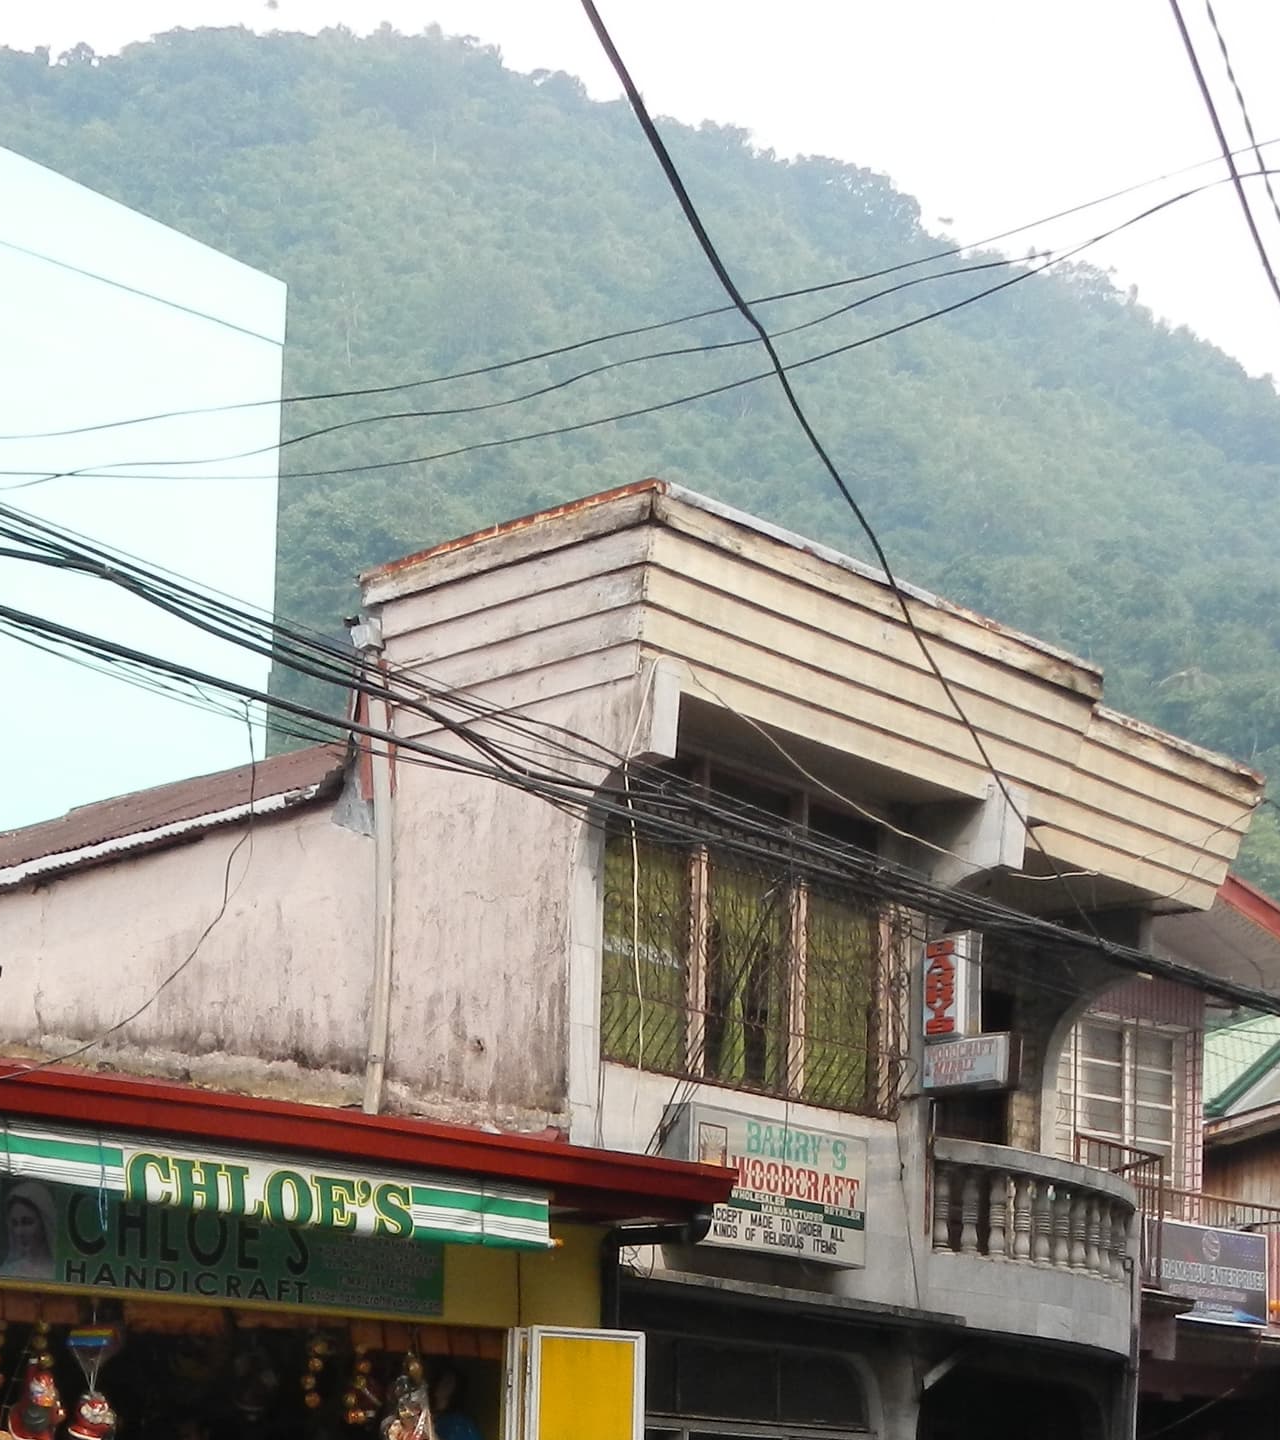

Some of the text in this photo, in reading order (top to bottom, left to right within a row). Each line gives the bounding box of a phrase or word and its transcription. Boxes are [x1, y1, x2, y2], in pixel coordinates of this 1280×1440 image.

[746, 1121, 847, 1171] BARRY'S
[125, 1152, 415, 1239] CHLOE'S
[730, 1189, 786, 1206] WHOLESALER
[731, 1155, 860, 1209] WOODCRAFT
[712, 1207, 845, 1242] CCEPT MADE TO ORDER ALL
[713, 1223, 837, 1255] KINDS OF RELIGIOUS ITEMS
[65, 1259, 308, 1304] HANDICRAFT
